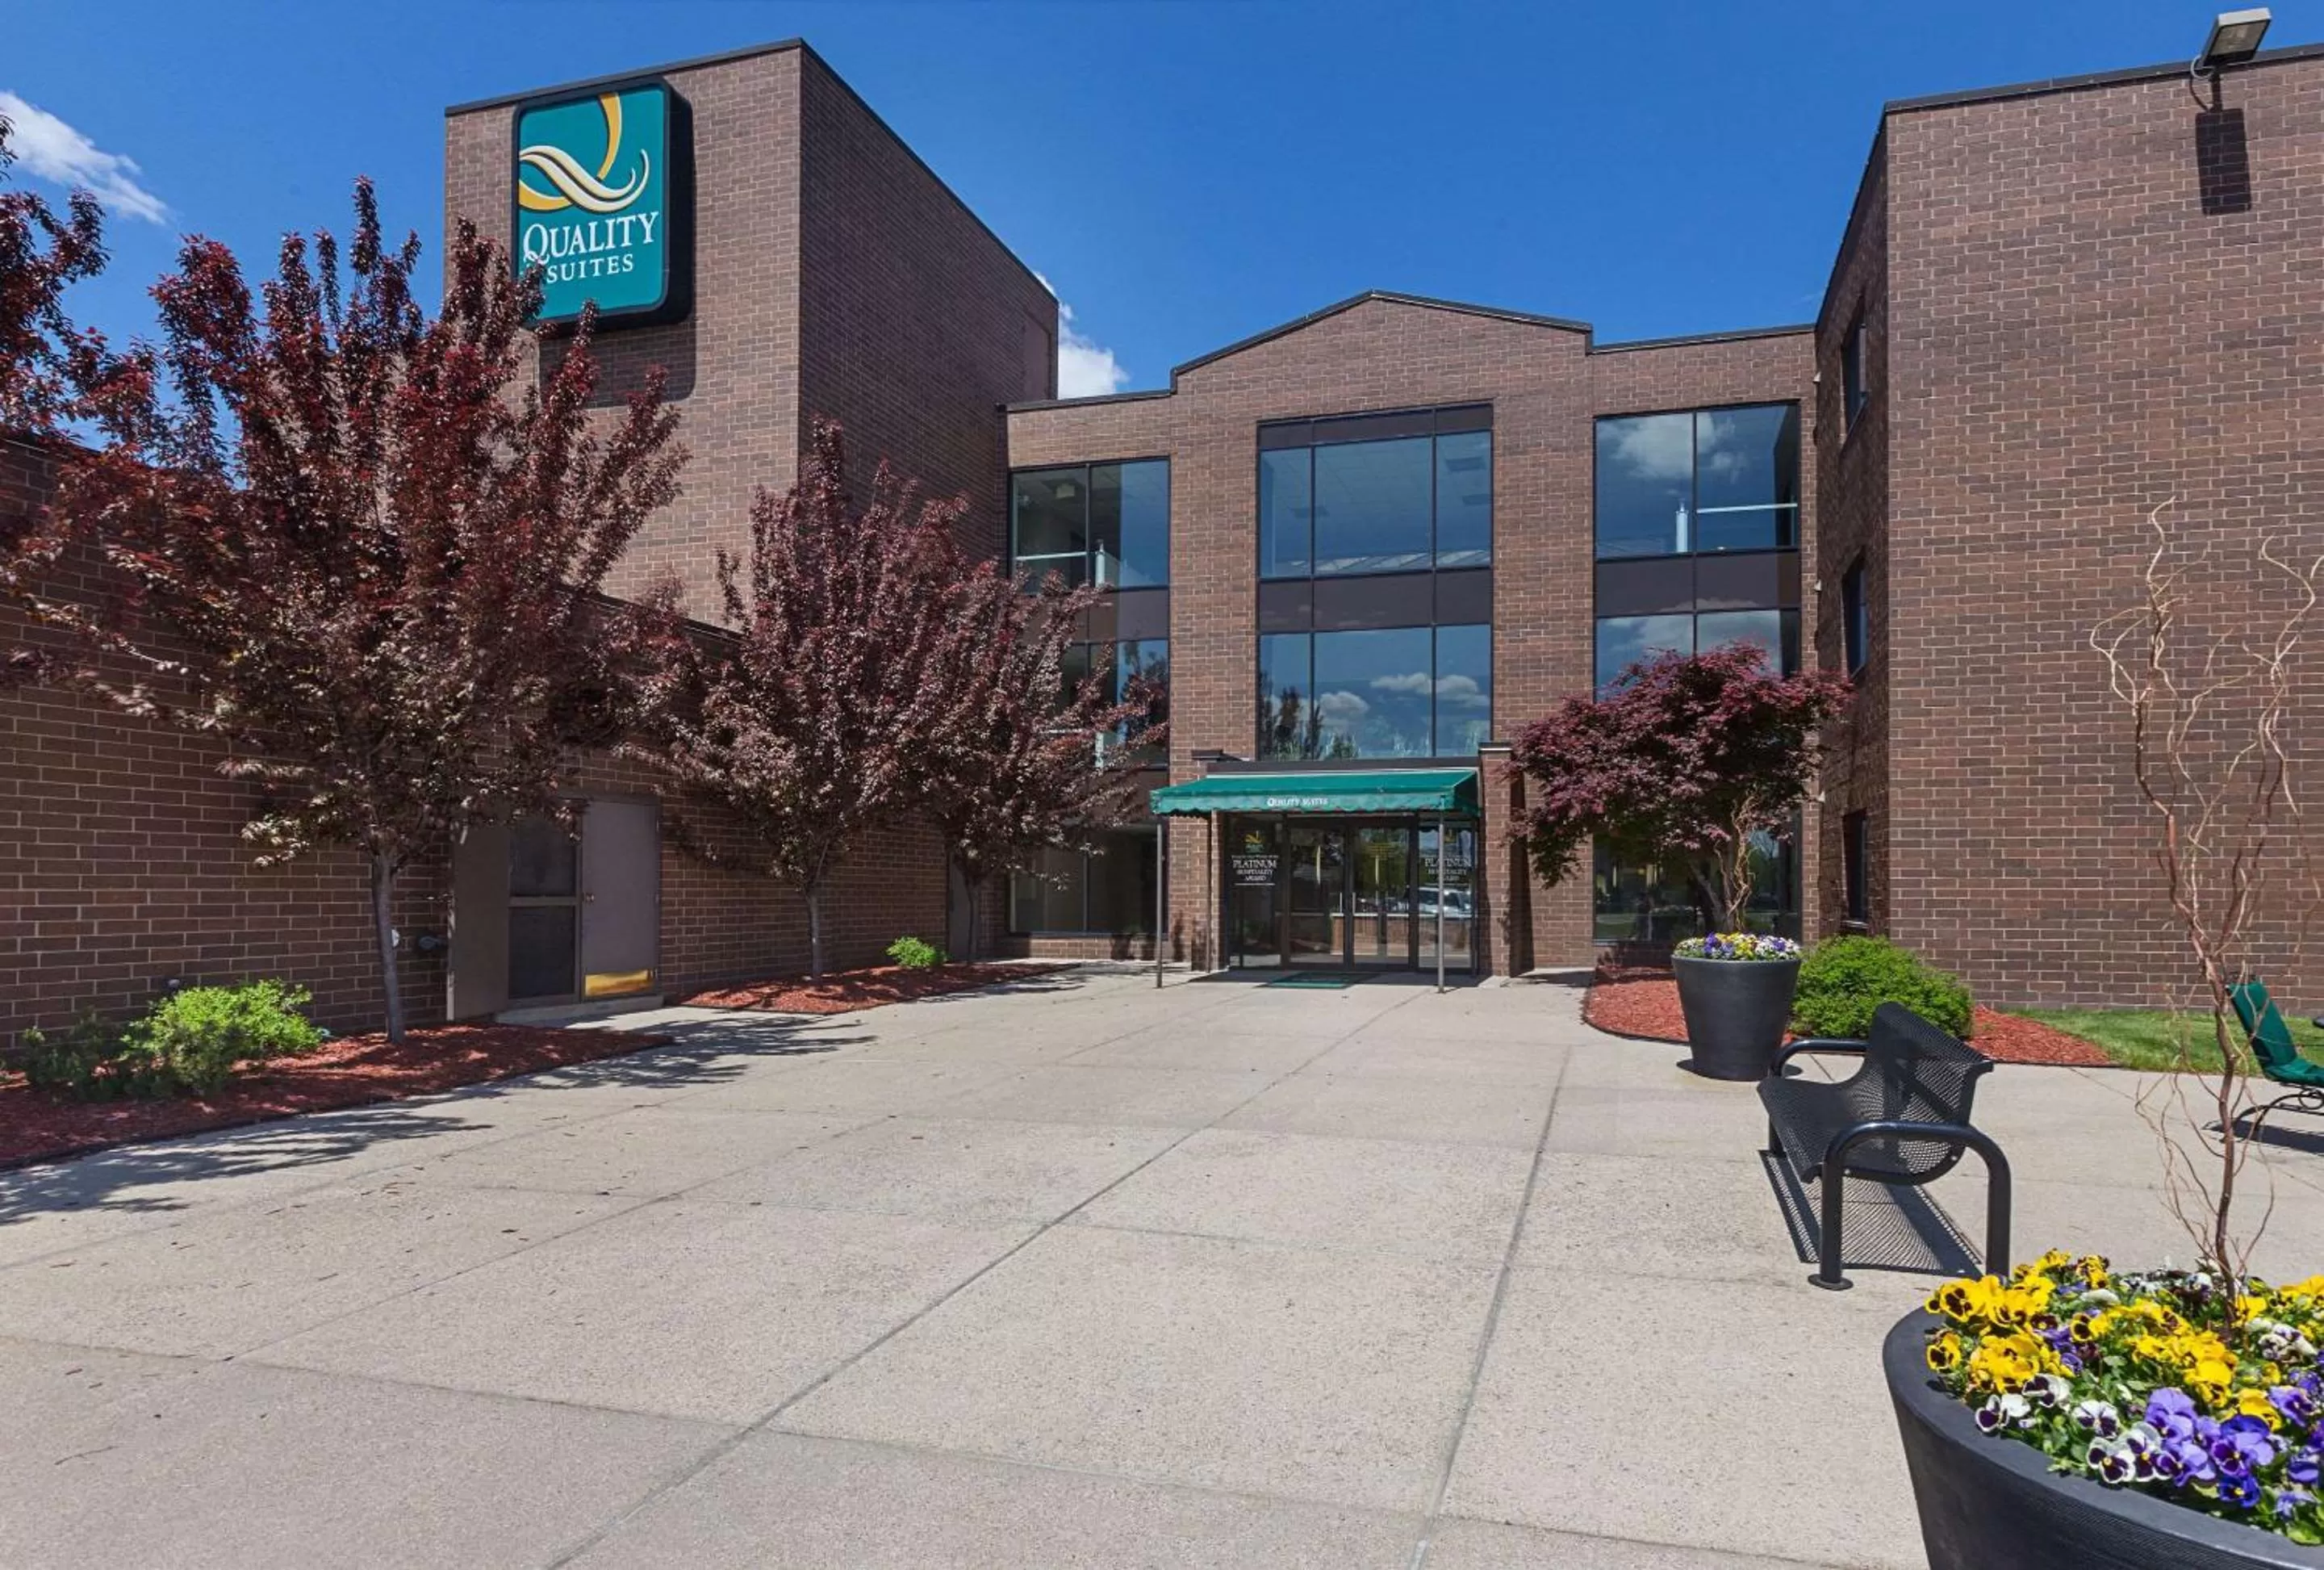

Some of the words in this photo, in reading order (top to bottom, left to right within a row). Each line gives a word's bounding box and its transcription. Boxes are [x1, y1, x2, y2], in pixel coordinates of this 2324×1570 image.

[523, 211, 658, 264] QUALITY
[545, 253, 633, 284] SUITES
[1267, 797, 1300, 806] QUALITY
[1232, 860, 1277, 869] PLATINUM
